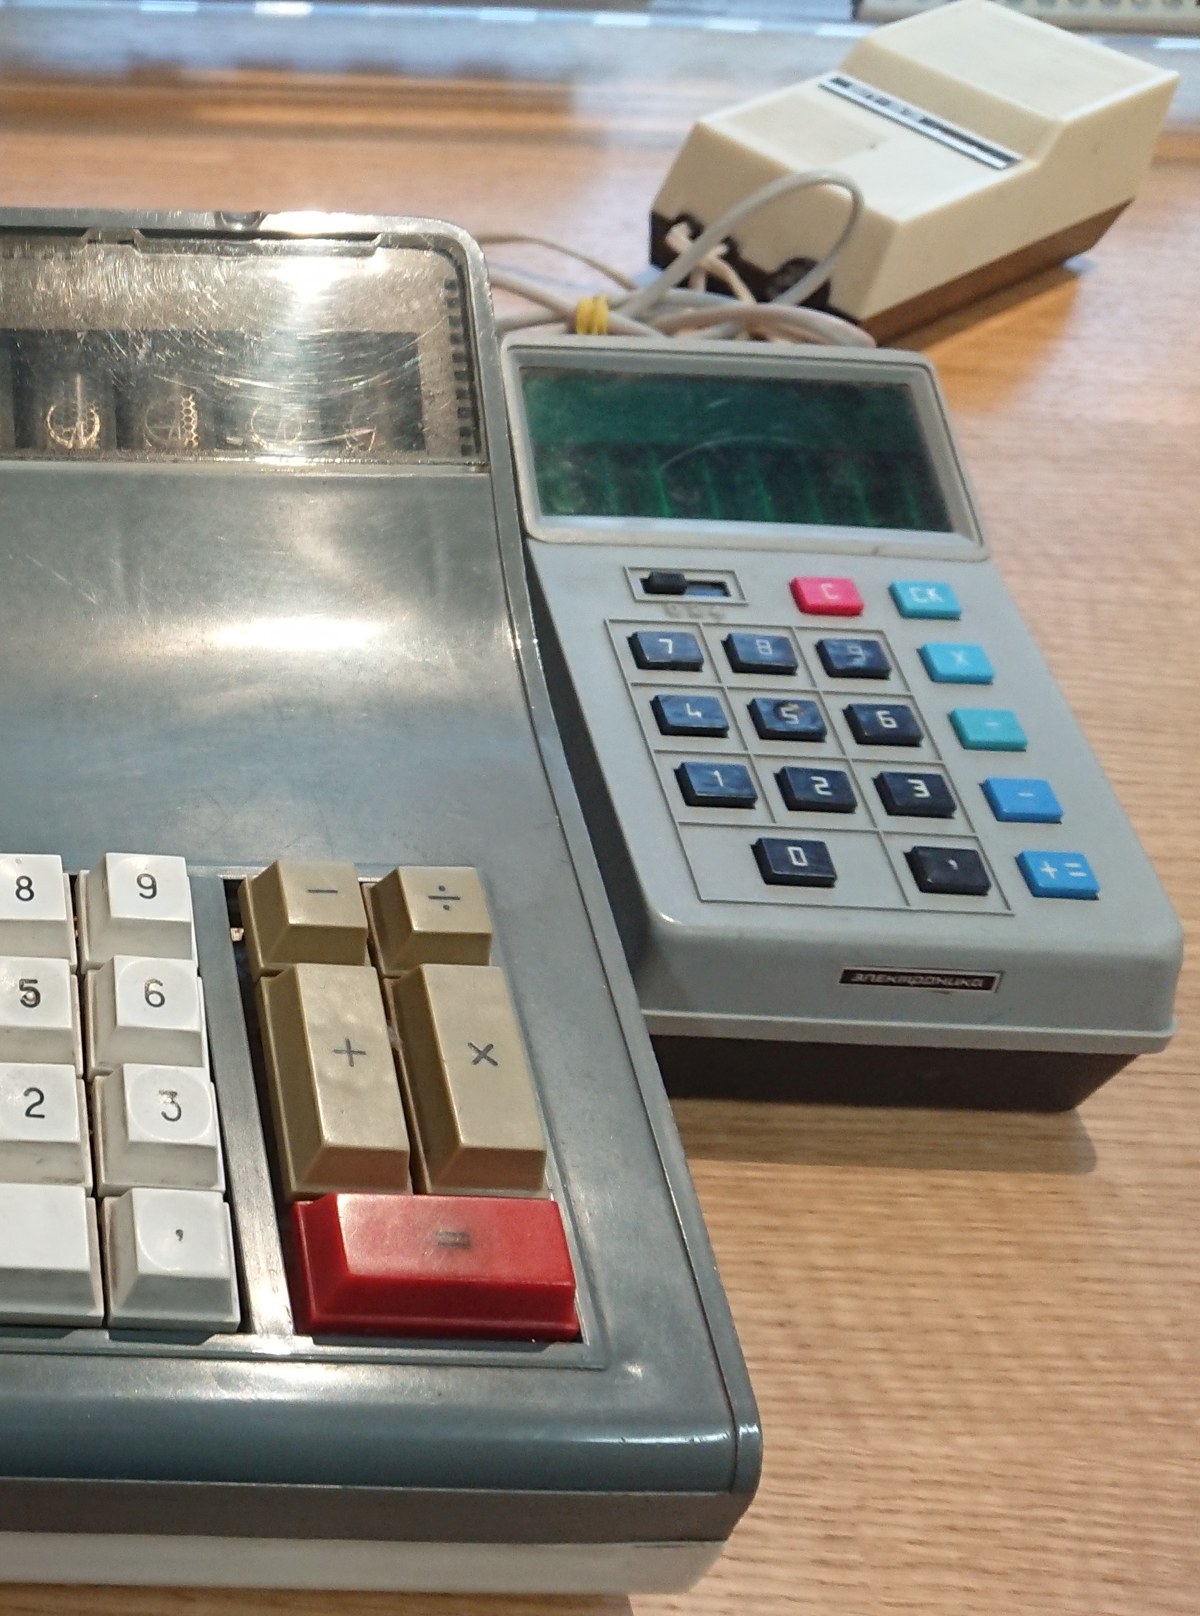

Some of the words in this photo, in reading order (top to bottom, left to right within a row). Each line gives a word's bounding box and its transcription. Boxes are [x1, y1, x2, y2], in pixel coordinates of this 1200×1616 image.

[659, 639, 672, 654] 7
[755, 638, 773, 656] 8
[849, 644, 867, 666] 9
[686, 704, 701, 717] 4
[781, 705, 799, 724] 5
[876, 711, 897, 728] 6
[714, 771, 723, 786] 1
[811, 777, 832, 795] 2
[908, 779, 930, 797] 3
[788, 847, 808, 866] 0
[16, 876, 34, 901] 8
[137, 874, 157, 899] 9
[19, 979, 40, 1008] 5
[145, 980, 165, 1007] 6
[24, 1088, 45, 1118] 2
[159, 1088, 183, 1122] 3
